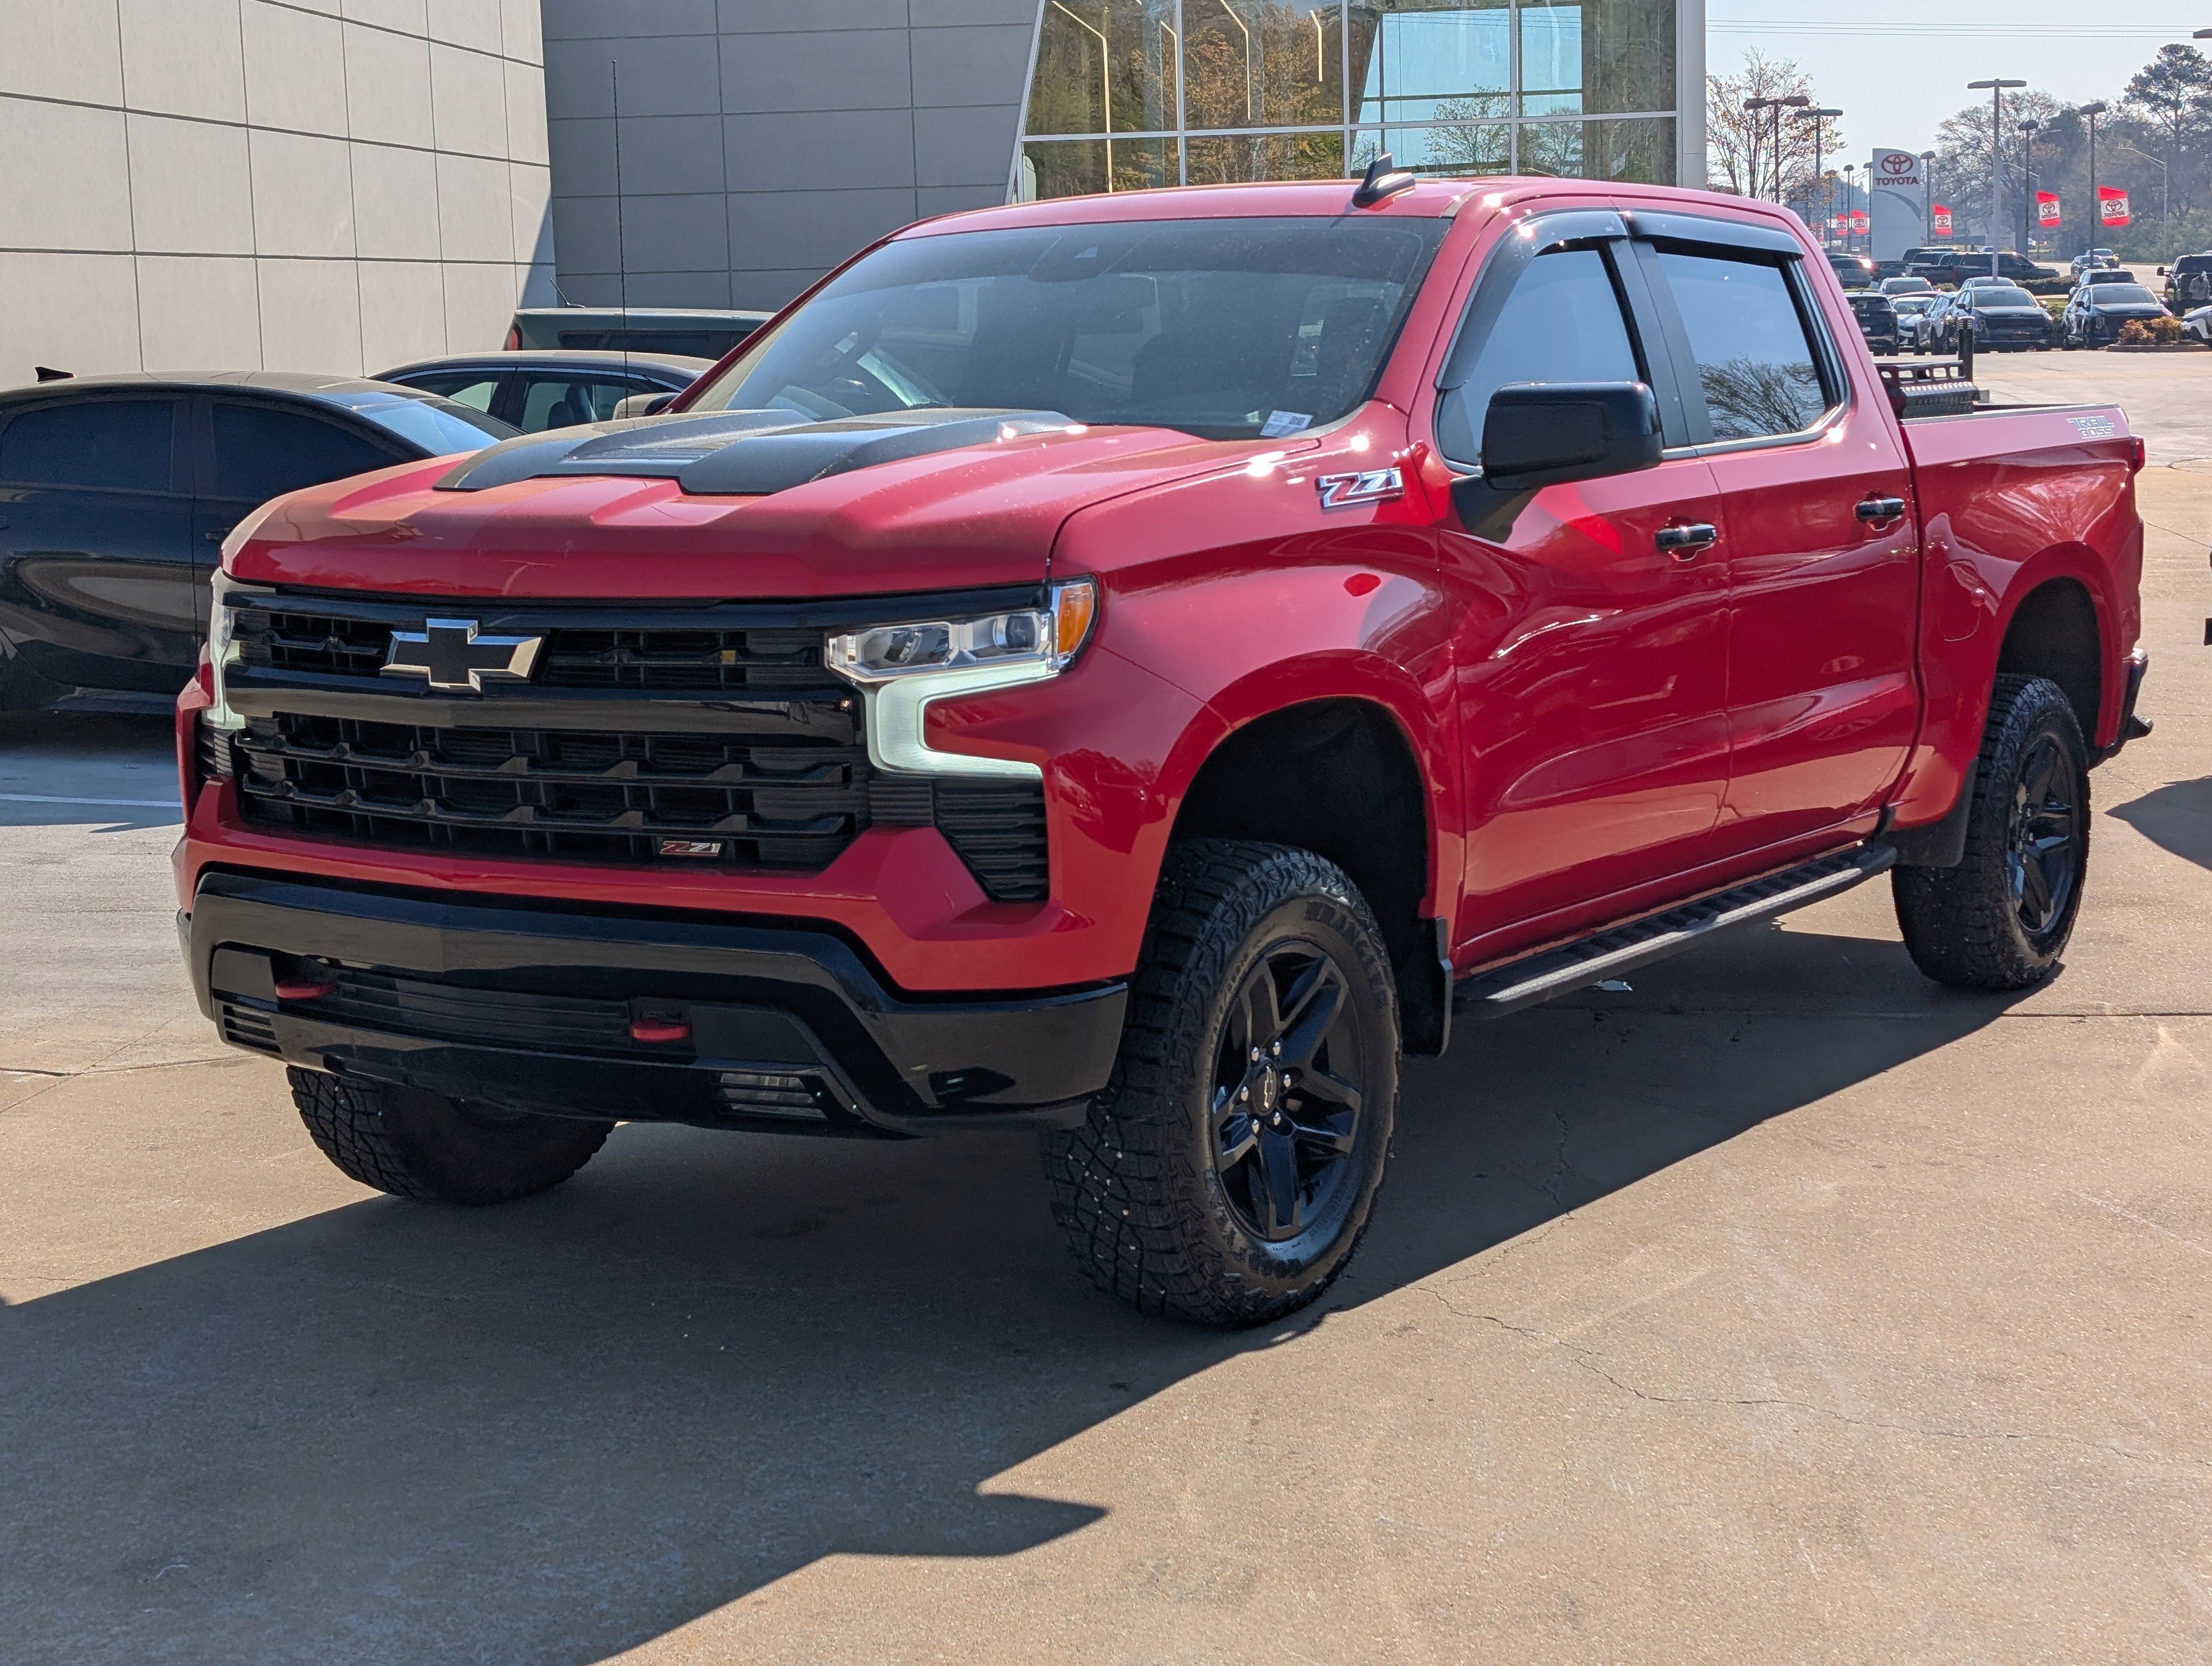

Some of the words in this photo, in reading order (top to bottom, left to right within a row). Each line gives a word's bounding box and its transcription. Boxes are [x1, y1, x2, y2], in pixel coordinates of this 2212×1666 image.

[1875, 177, 1919, 185] TOYOTA
[2066, 415, 2115, 430] TRAIL
[2079, 427, 2114, 439] BOSS
[1315, 467, 1405, 509] Z71
[660, 841, 722, 856] Z71
